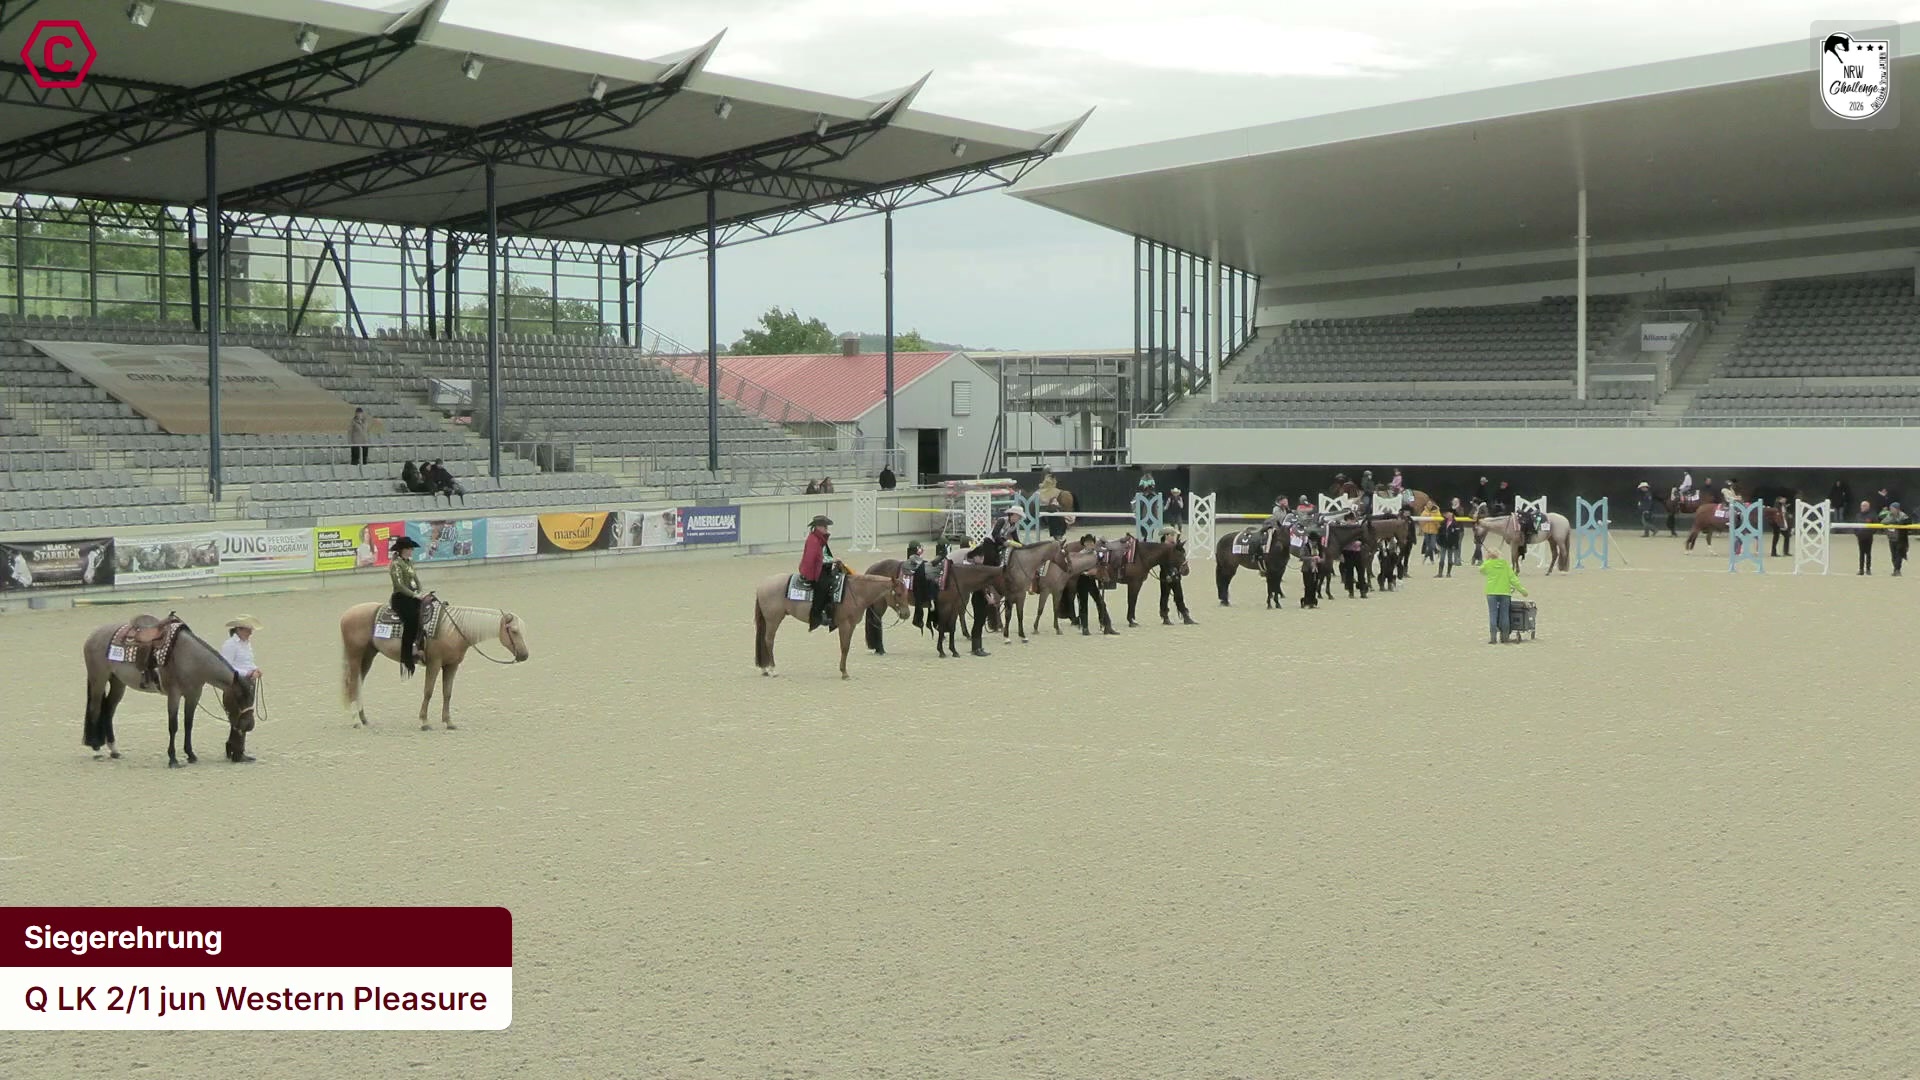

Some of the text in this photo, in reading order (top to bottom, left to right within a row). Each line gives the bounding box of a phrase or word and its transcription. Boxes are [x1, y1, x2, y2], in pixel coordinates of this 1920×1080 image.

[687, 515, 736, 530] AMERICANA
[554, 527, 591, 540] marstall
[46, 543, 68, 551] BLACK
[222, 537, 267, 554] JUNG
[268, 543, 310, 553] PROGRAMM
[33, 548, 80, 561] STARBUCK
